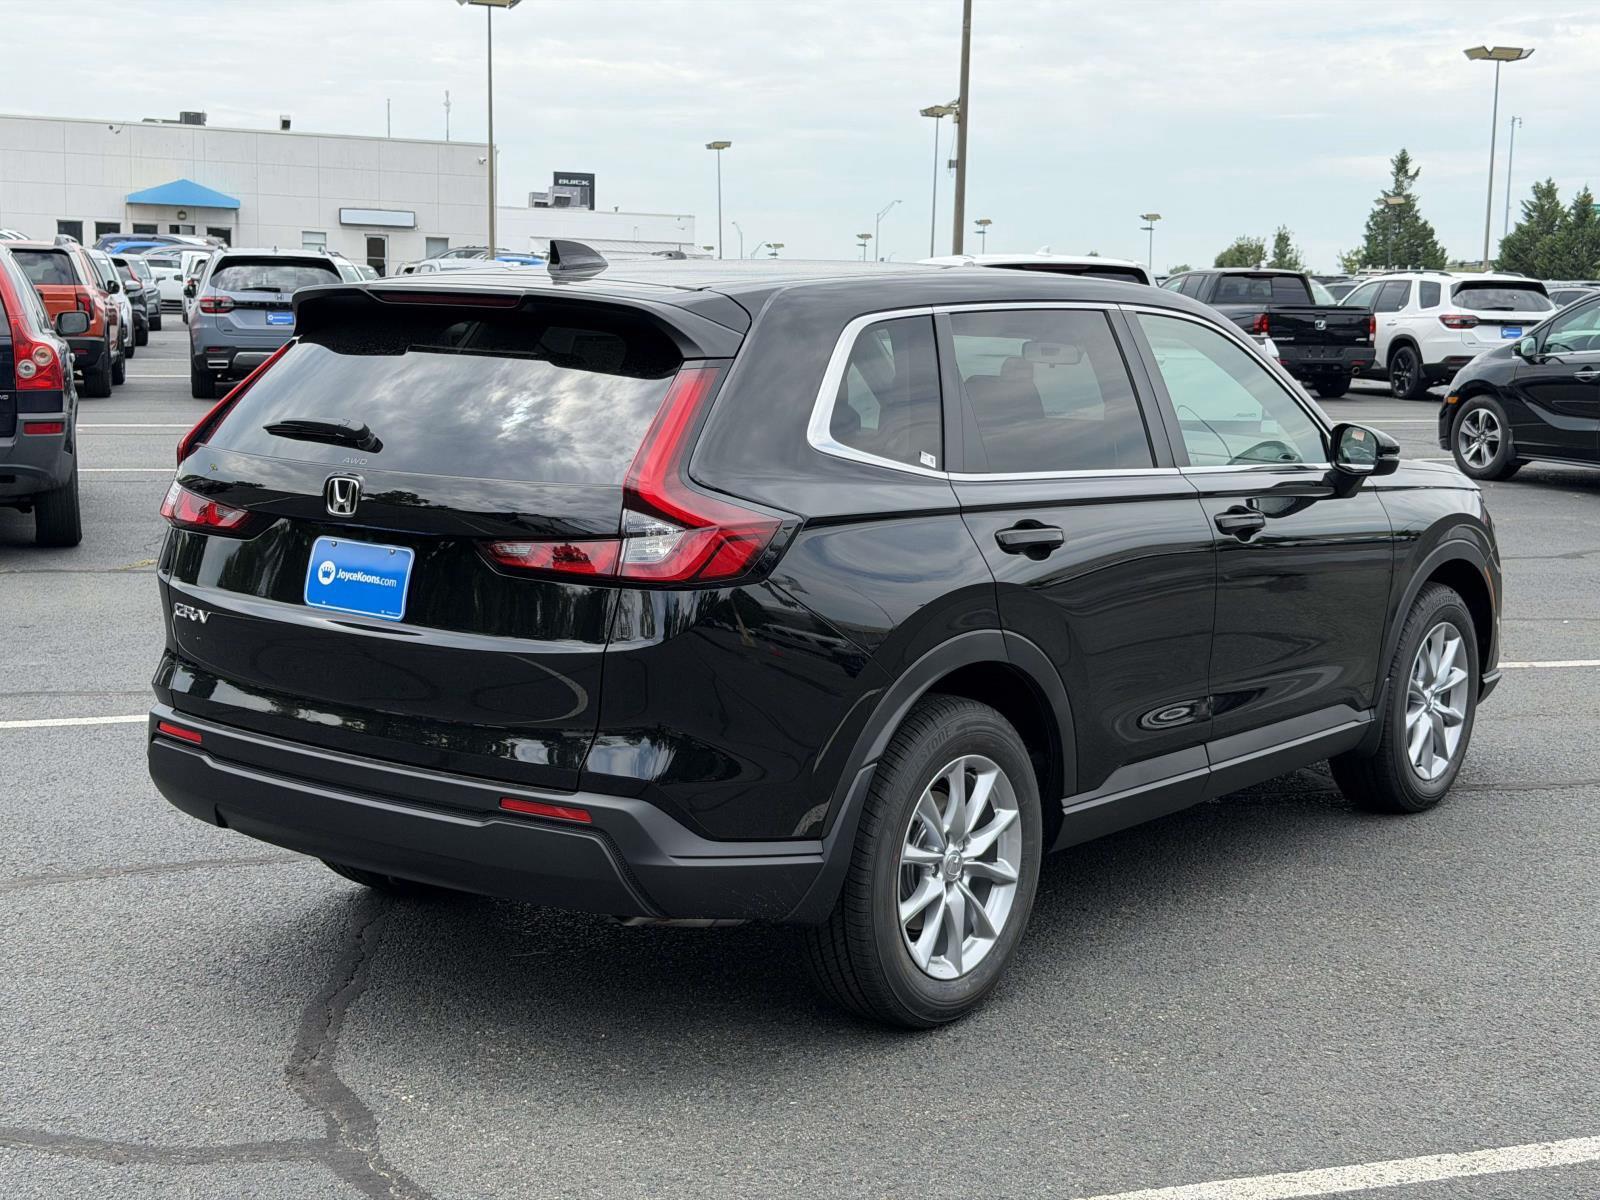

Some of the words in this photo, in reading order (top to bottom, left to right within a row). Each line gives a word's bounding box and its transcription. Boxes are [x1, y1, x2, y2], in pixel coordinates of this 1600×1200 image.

[558, 178, 590, 186] BUICK
[342, 457, 368, 465] AWD
[336, 568, 397, 588] JoyceKoons.com
